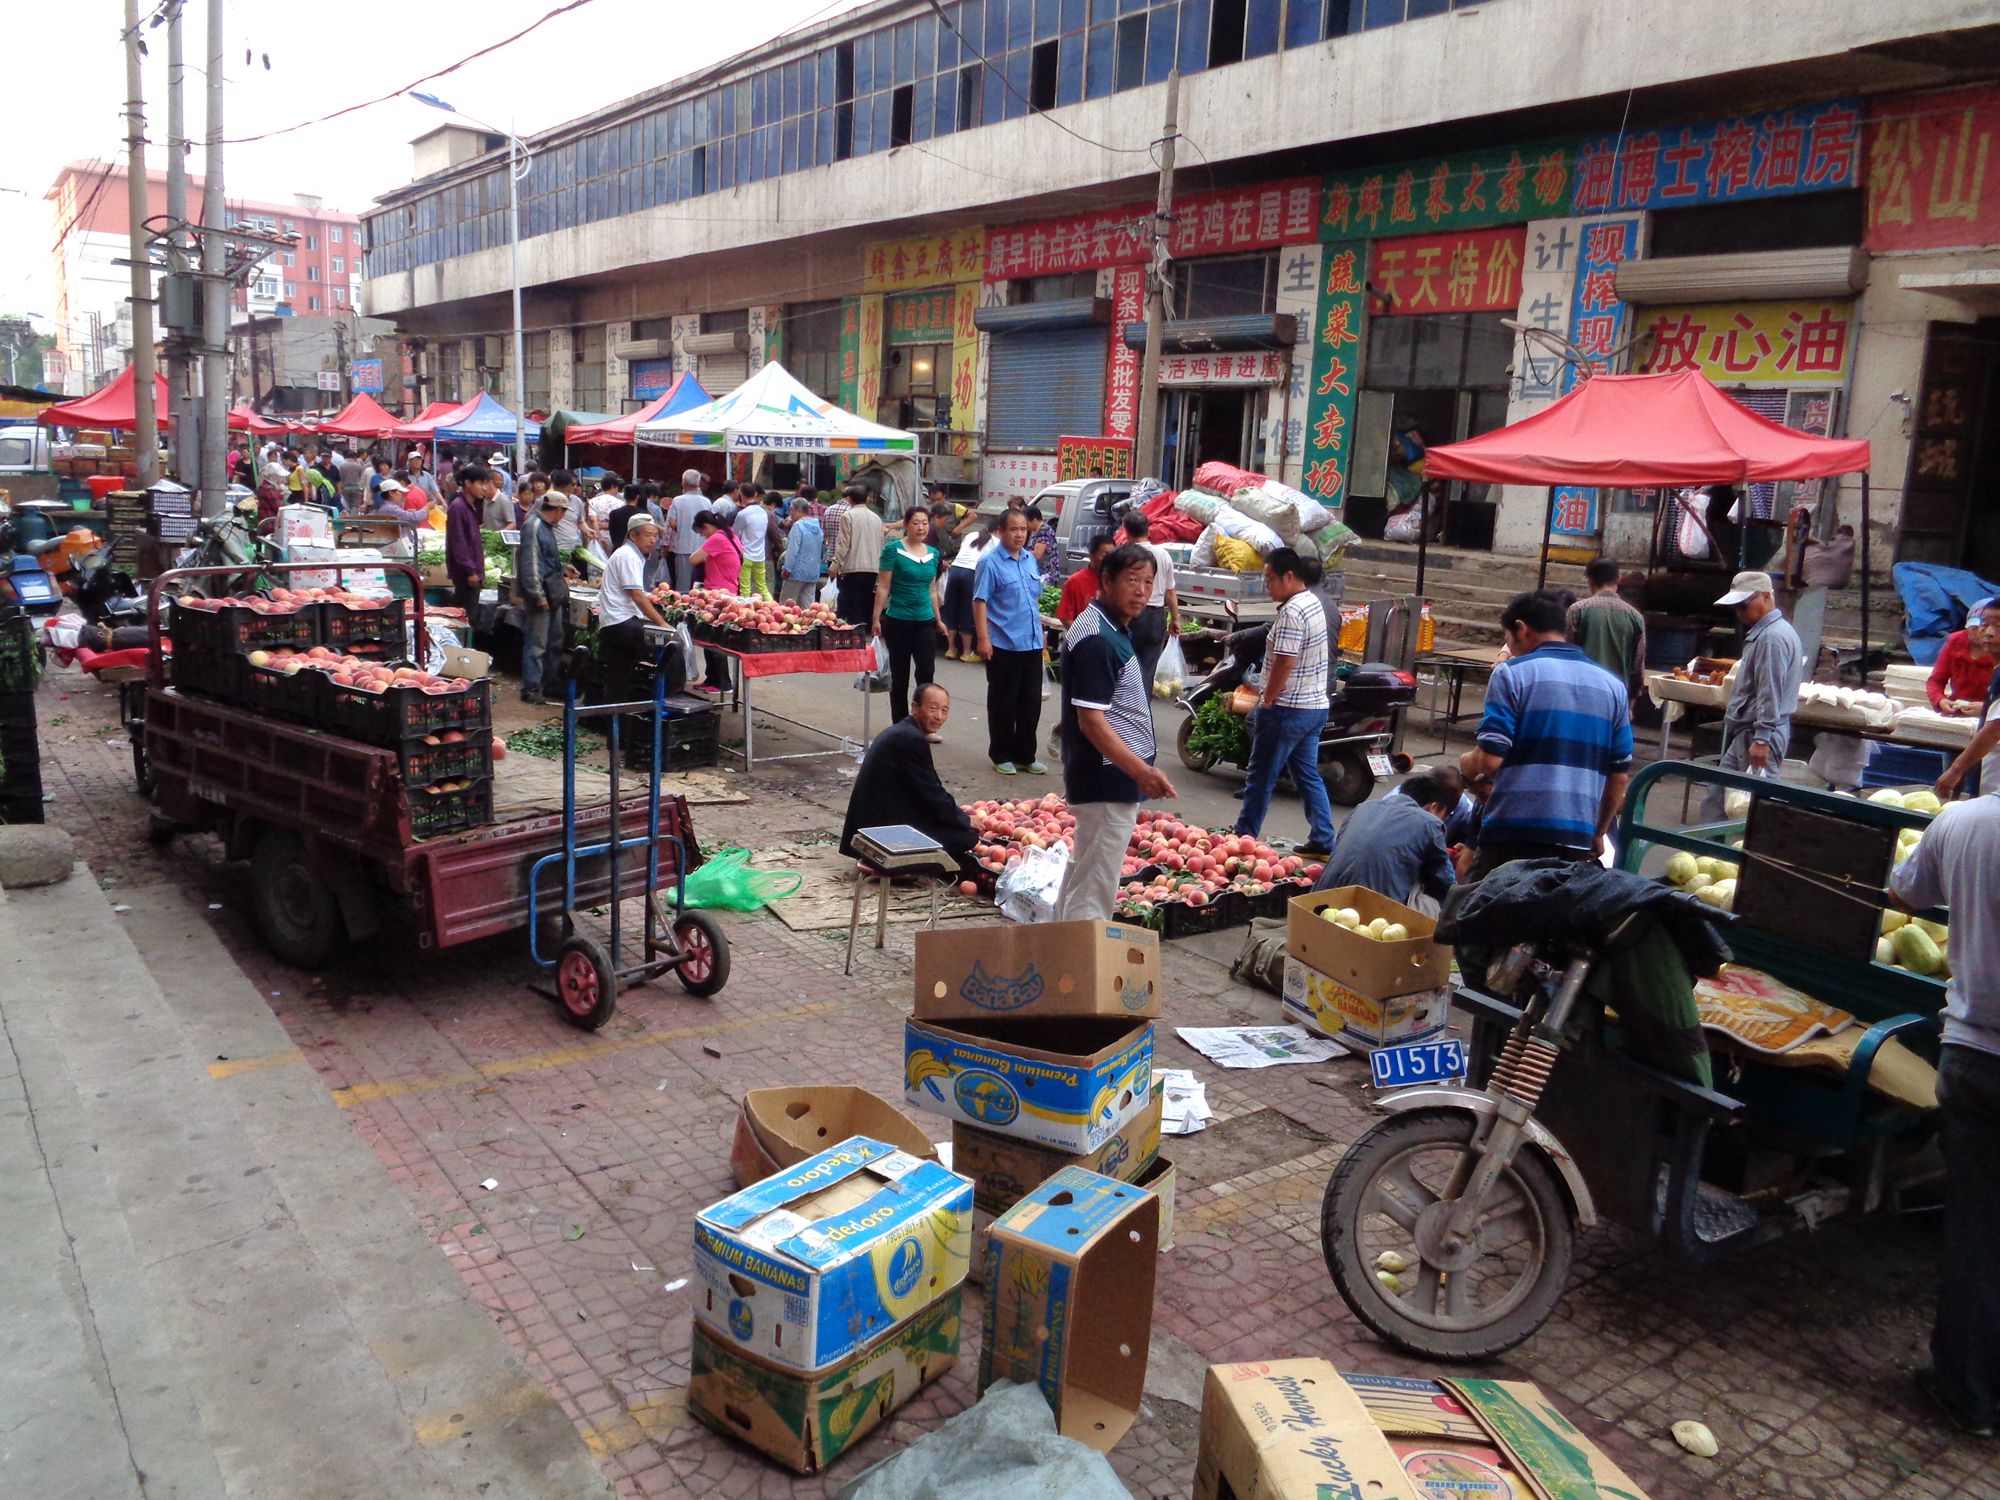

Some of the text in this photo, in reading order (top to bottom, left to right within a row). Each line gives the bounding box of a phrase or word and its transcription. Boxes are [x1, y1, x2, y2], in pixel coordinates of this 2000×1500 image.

[1573, 105, 1858, 209] 油博士榨油房
[1175, 186, 1312, 251] 活鸡在屋里
[1323, 151, 1568, 233] 新鲜蔬菜大卖场
[1377, 238, 1521, 308] 天天特价
[1109, 271, 1140, 440] 现杀现卖批发零
[1647, 307, 1848, 373] 放心油
[1304, 250, 1361, 499] 蔬菜大卖场
[735, 434, 824, 448] AUX 奥克斯手机
[953, 1047, 1079, 1087] Premium Bananas
[981, 1173, 1024, 1196] MSG
[827, 1206, 896, 1242] dedoro
[695, 1228, 743, 1266] PREMIUM
[744, 1255, 806, 1291] BANANAS
[893, 1258, 922, 1292] dedoro
[1346, 1376, 1394, 1387] EMIUM
[1264, 1375, 1363, 1500] Lucky Harvest
